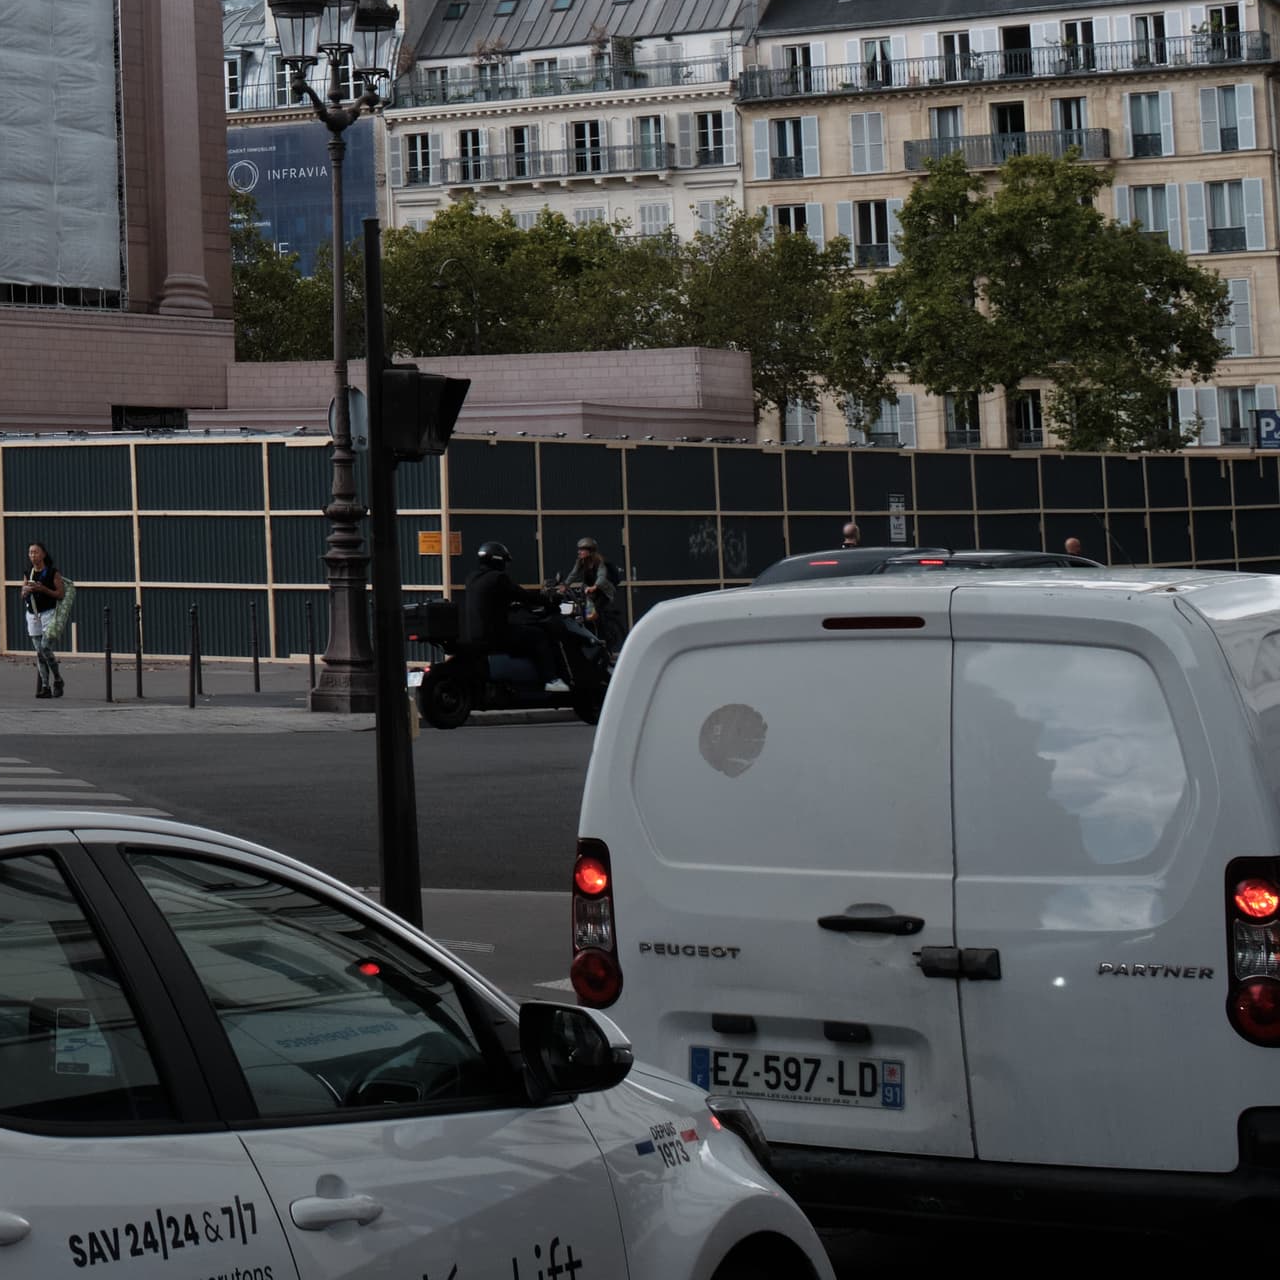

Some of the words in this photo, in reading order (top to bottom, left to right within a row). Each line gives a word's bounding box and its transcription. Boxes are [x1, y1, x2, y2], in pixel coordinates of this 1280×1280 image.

[267, 165, 328, 181] INFRAVIA
[1260, 417, 1276, 439] P
[639, 942, 741, 959] PEUGEOT
[1098, 962, 1215, 980] PARTNER
[712, 1051, 878, 1097] EZ-597-LD
[884, 1086, 901, 1105] 91
[649, 1121, 677, 1140] DEPUIS
[657, 1140, 690, 1169] 1973
[69, 1228, 120, 1267] SAV
[203, 1211, 223, 1242] &
